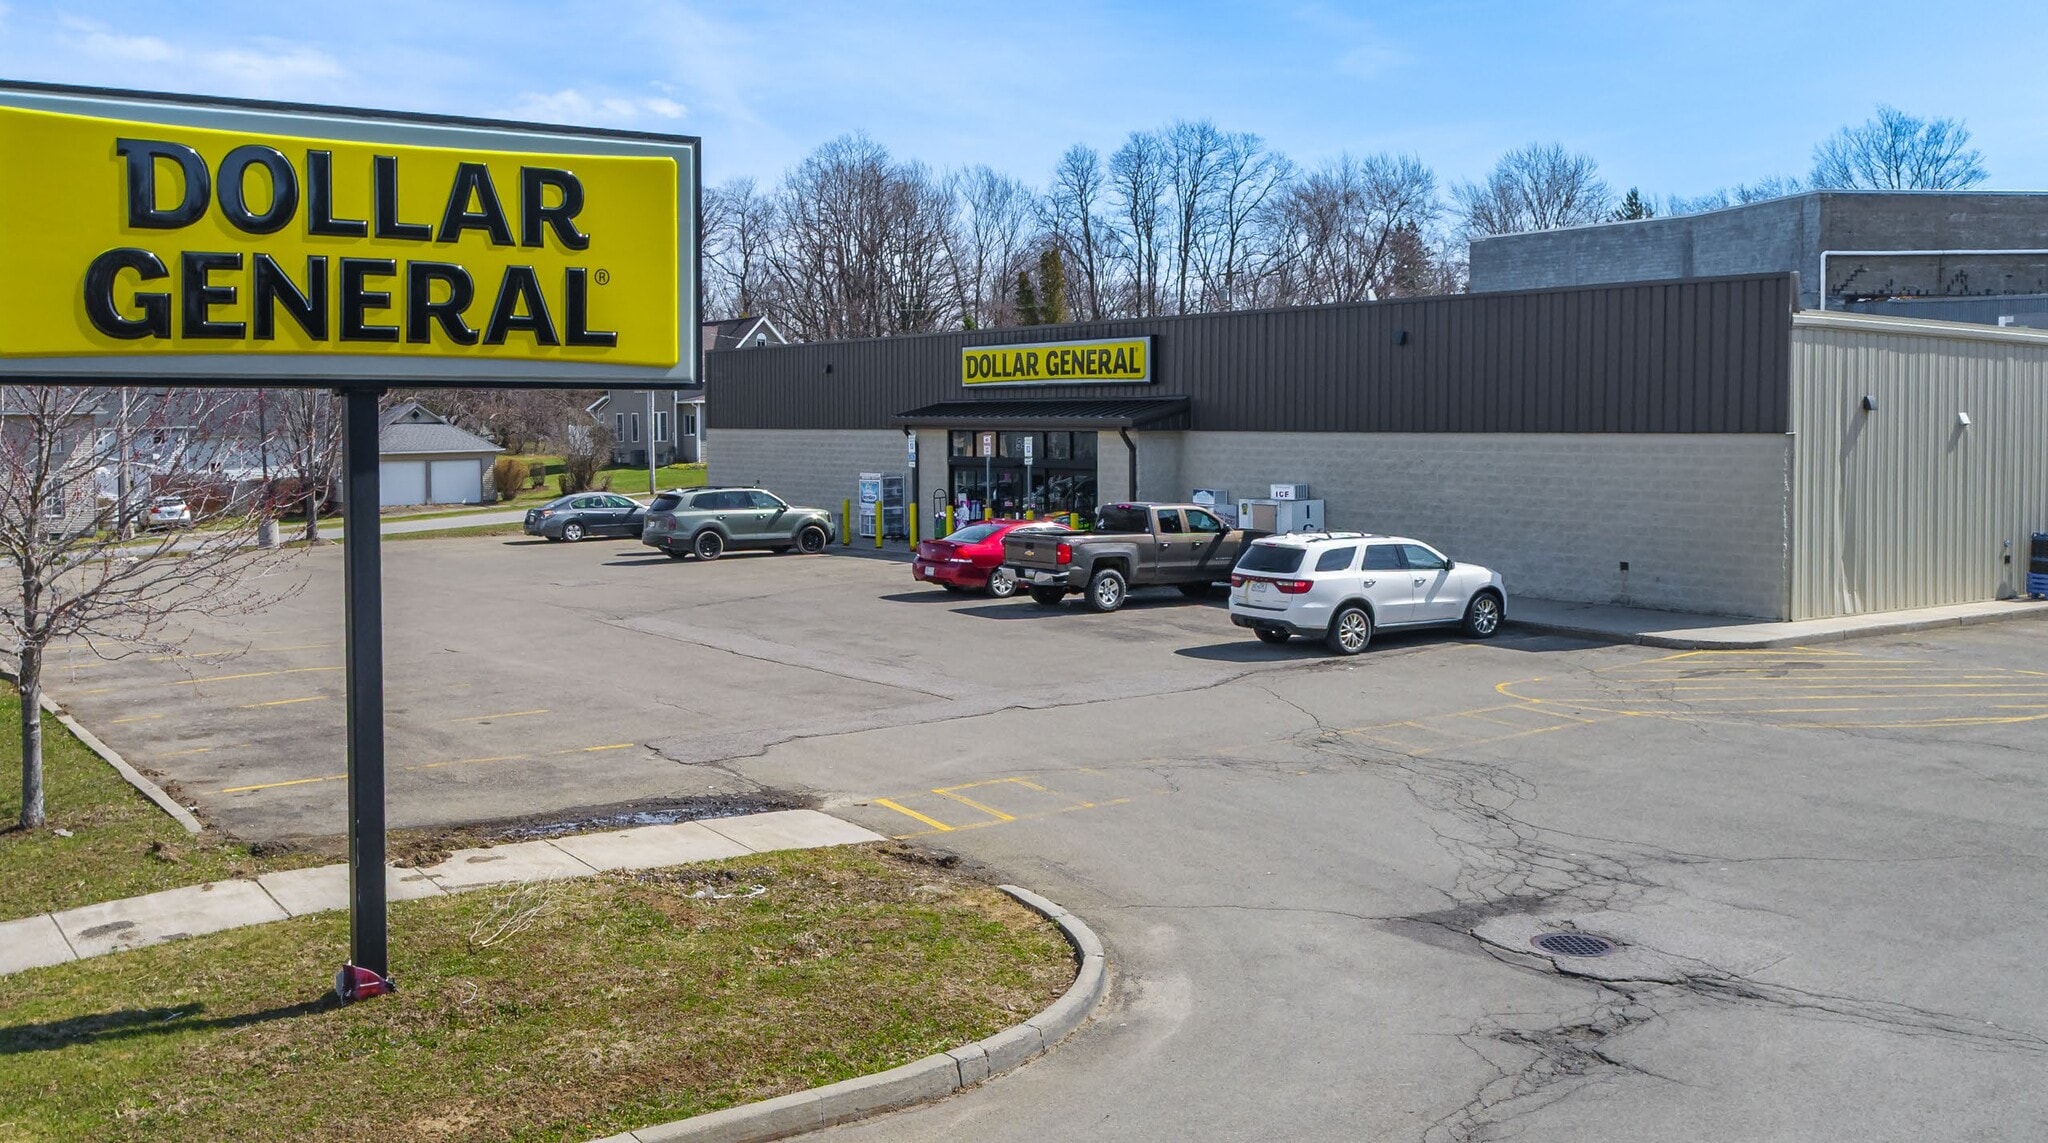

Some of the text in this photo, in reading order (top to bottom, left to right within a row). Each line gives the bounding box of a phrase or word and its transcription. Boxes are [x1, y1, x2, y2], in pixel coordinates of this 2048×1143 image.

[115, 137, 591, 251] DOLLAR
[965, 346, 1141, 379] DOLLAR GENERAL
